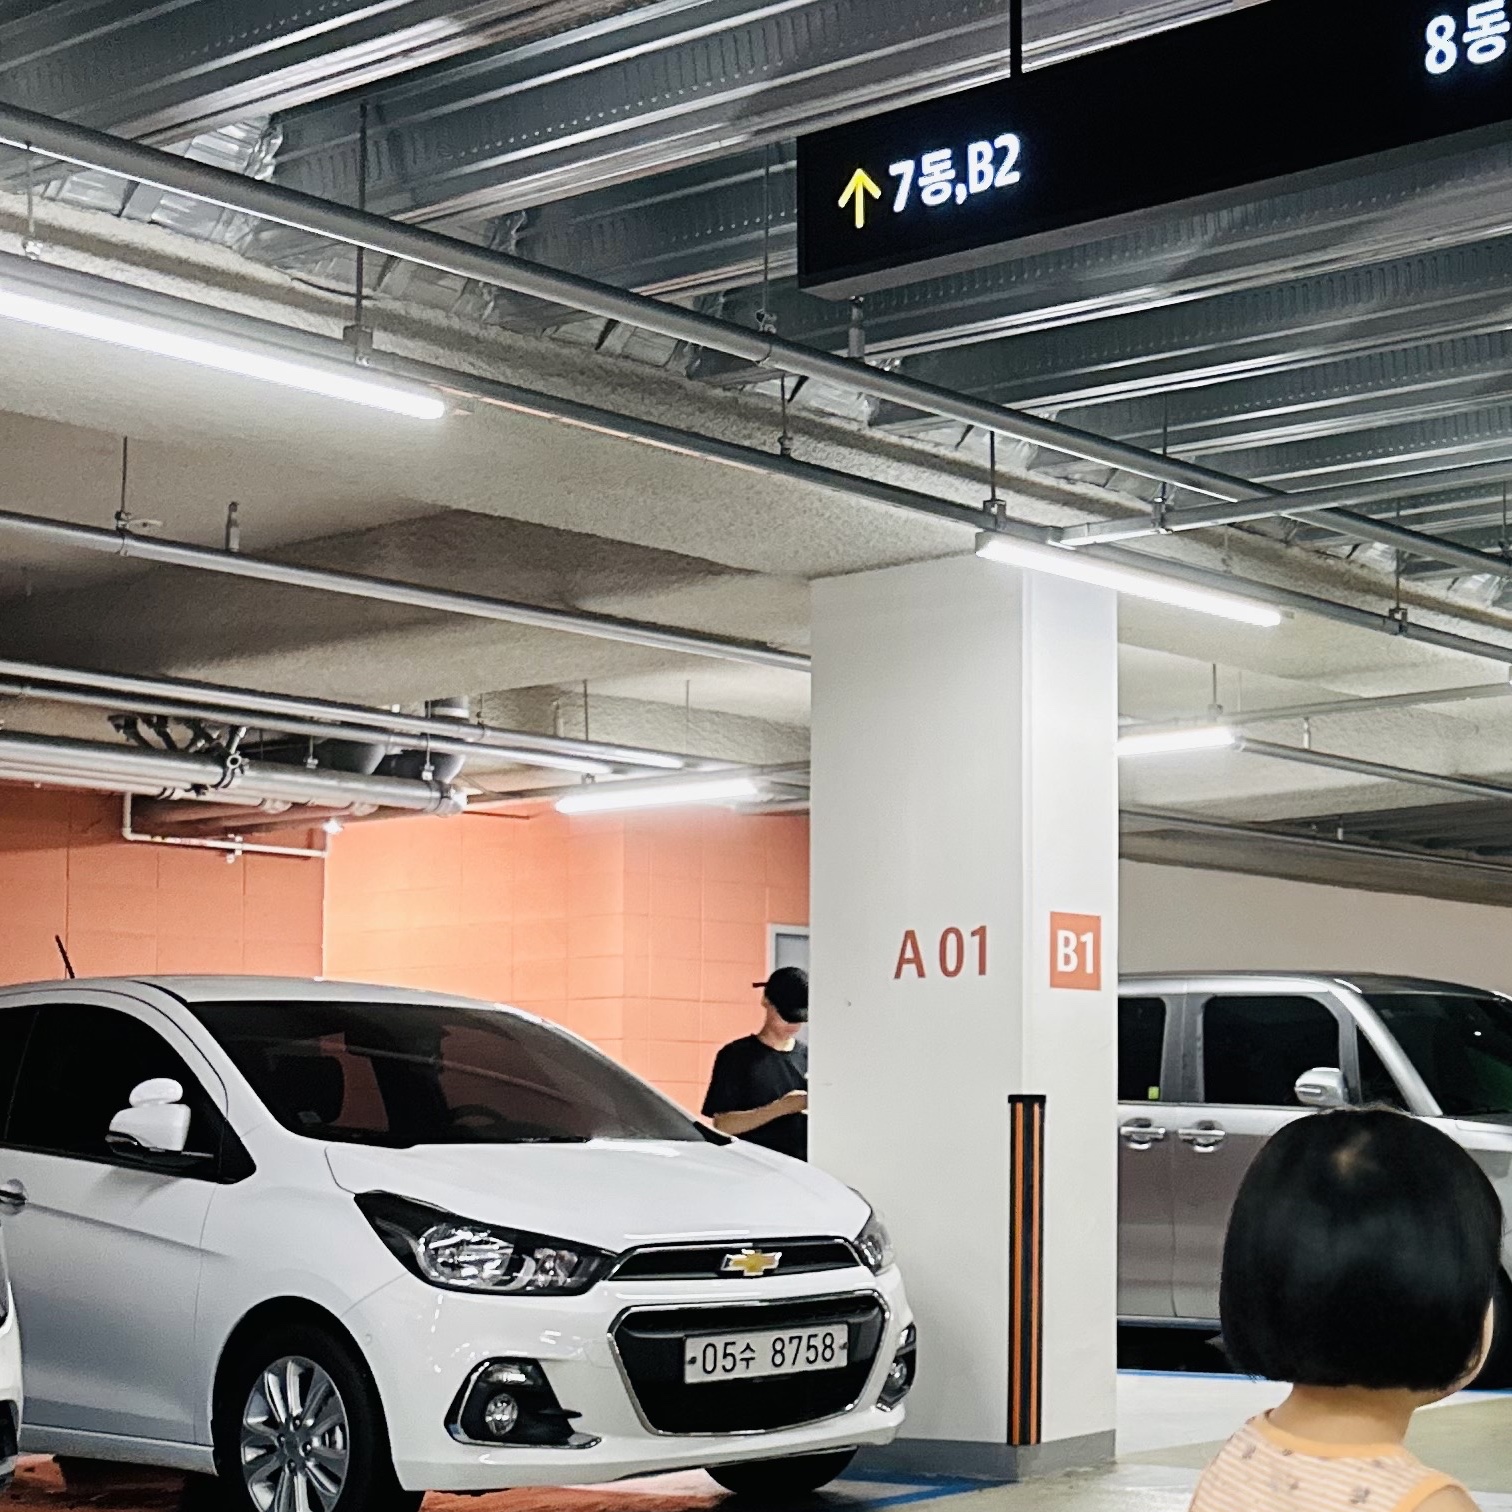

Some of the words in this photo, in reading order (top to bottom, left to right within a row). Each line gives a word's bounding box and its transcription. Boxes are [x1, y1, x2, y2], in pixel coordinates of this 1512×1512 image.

[1425, 0, 1511, 75] 8동
[888, 133, 1021, 213] 7동,B2
[893, 929, 926, 979] A
[939, 925, 987, 978] 01
[1056, 929, 1094, 974] B1
[702, 1341, 756, 1375] 05수
[771, 1332, 835, 1368] 8758
